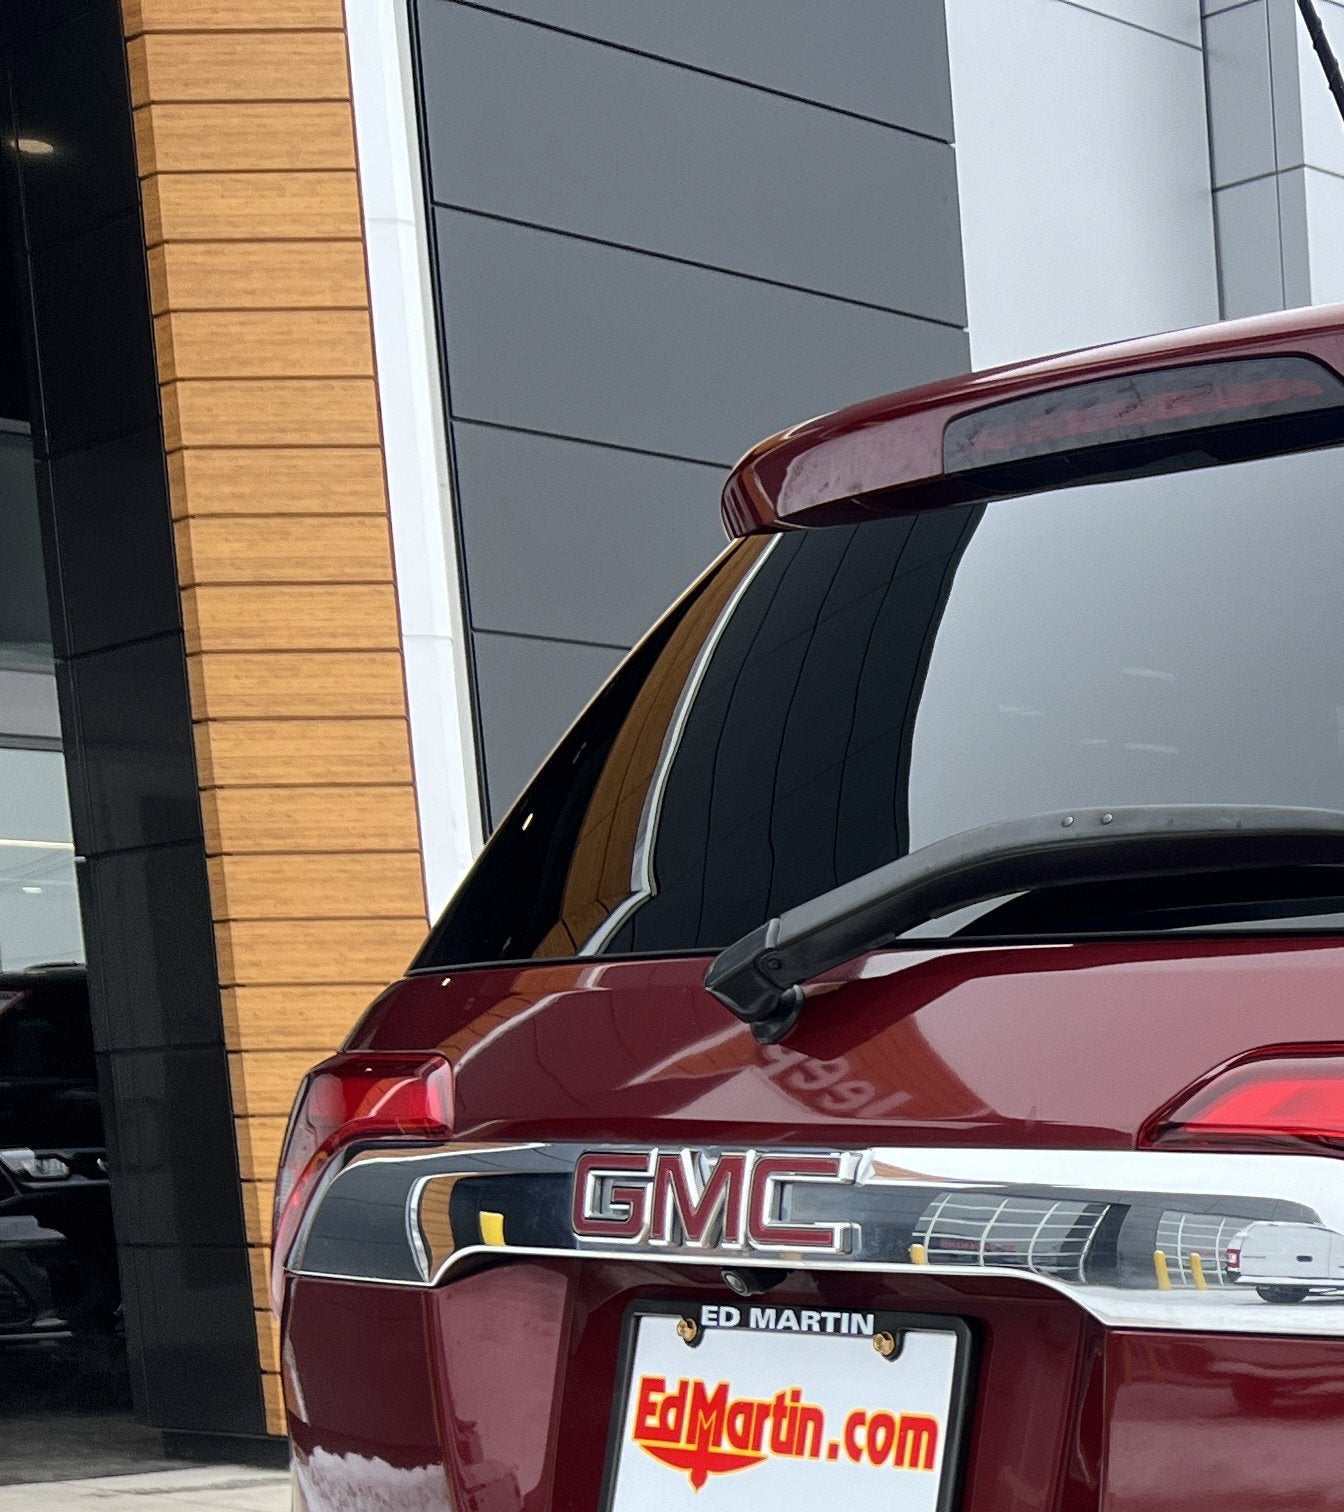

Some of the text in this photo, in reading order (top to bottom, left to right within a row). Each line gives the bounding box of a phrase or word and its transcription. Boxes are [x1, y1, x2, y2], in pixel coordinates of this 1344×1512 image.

[572, 1148, 863, 1255] GMC
[701, 1304, 876, 1336] ED MARTIN
